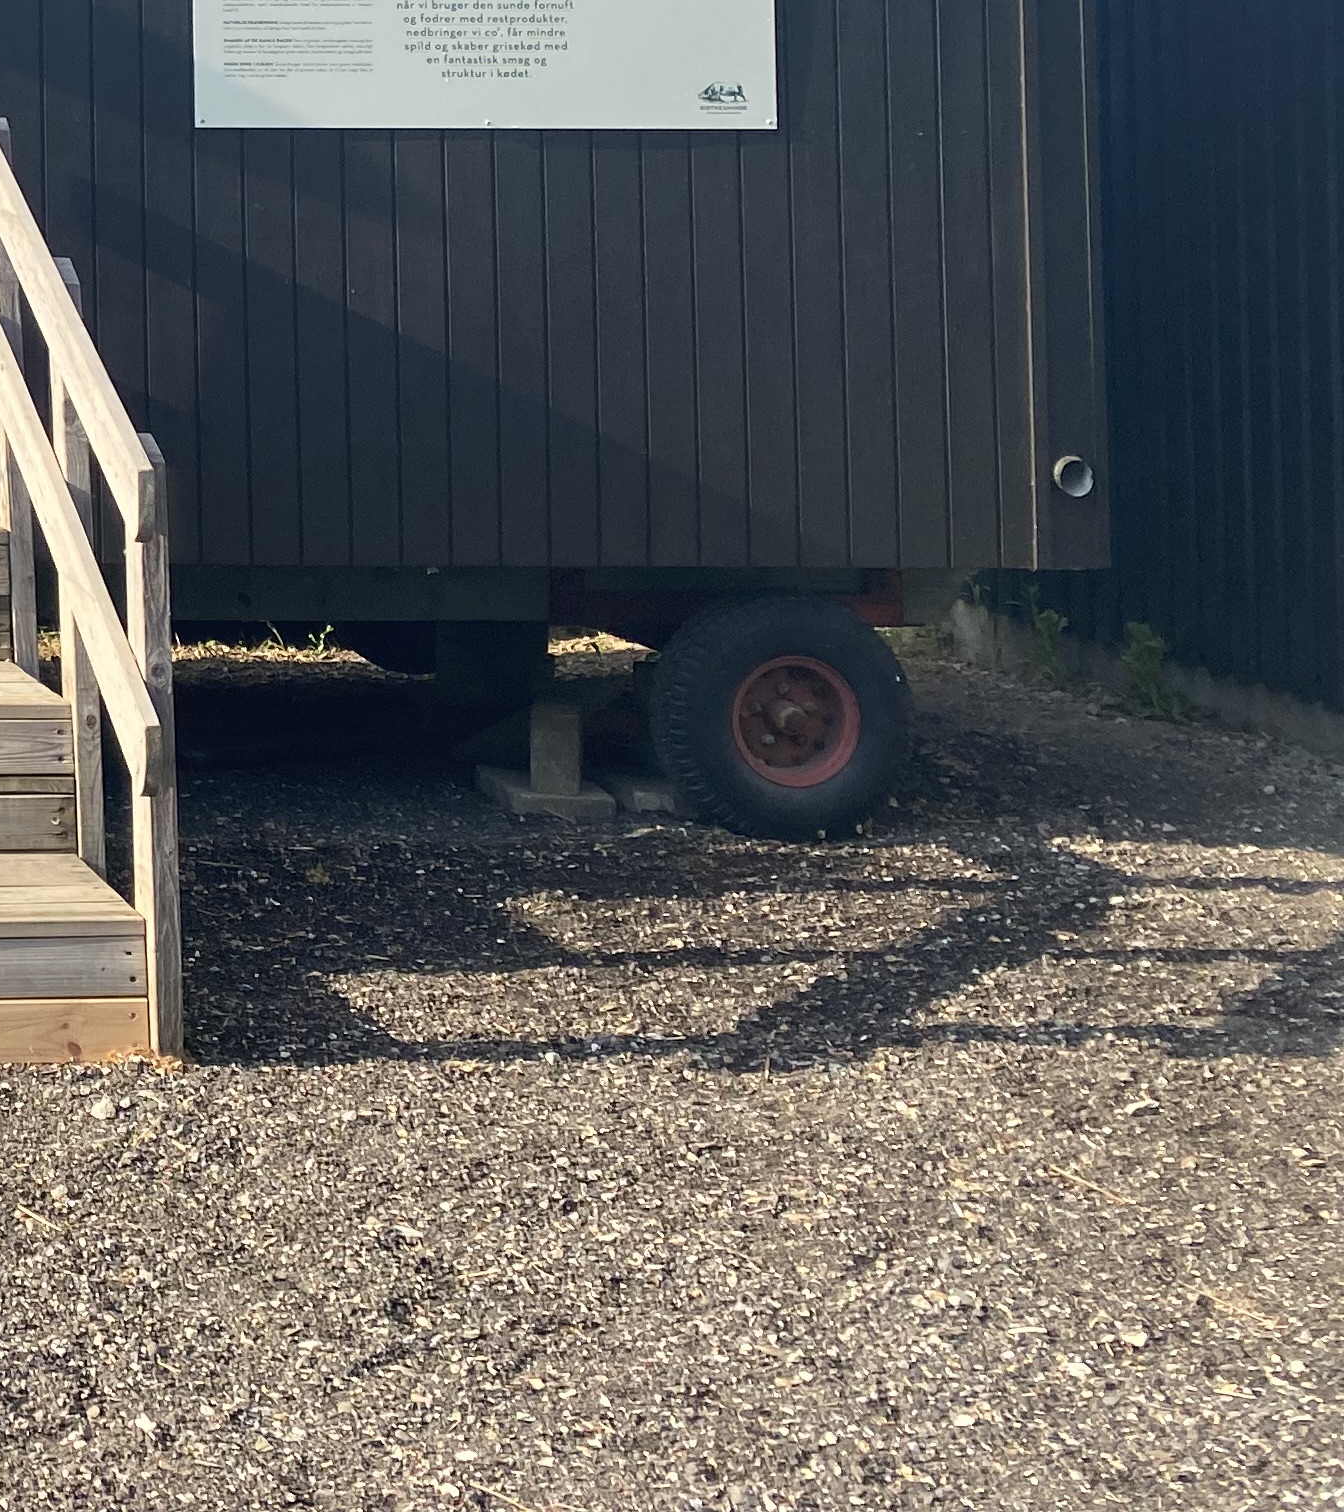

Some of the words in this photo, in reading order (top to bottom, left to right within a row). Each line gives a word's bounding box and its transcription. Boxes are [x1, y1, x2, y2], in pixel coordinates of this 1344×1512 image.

[397, 0, 415, 10] når
[419, 0, 427, 10] vi
[432, 0, 469, 11] bruger
[473, 0, 493, 10] den
[497, 0, 530, 10] sunde
[534, 0, 574, 10] fornuft
[403, 16, 416, 25] og
[421, 14, 455, 23] fodrer
[459, 14, 483, 23] med
[406, 28, 468, 39] nedbringer
[472, 28, 481, 36] vi
[507, 28, 523, 36] får
[527, 28, 565, 36] mindre
[404, 42, 431, 53] spild
[435, 44, 448, 53] og
[452, 42, 488, 50] skaber
[493, 42, 540, 53] grisekød
[544, 42, 568, 50] med
[444, 55, 498, 64] fantastisk
[502, 58, 530, 66] smag
[534, 58, 547, 66] og
[442, 69, 487, 78] struktur
